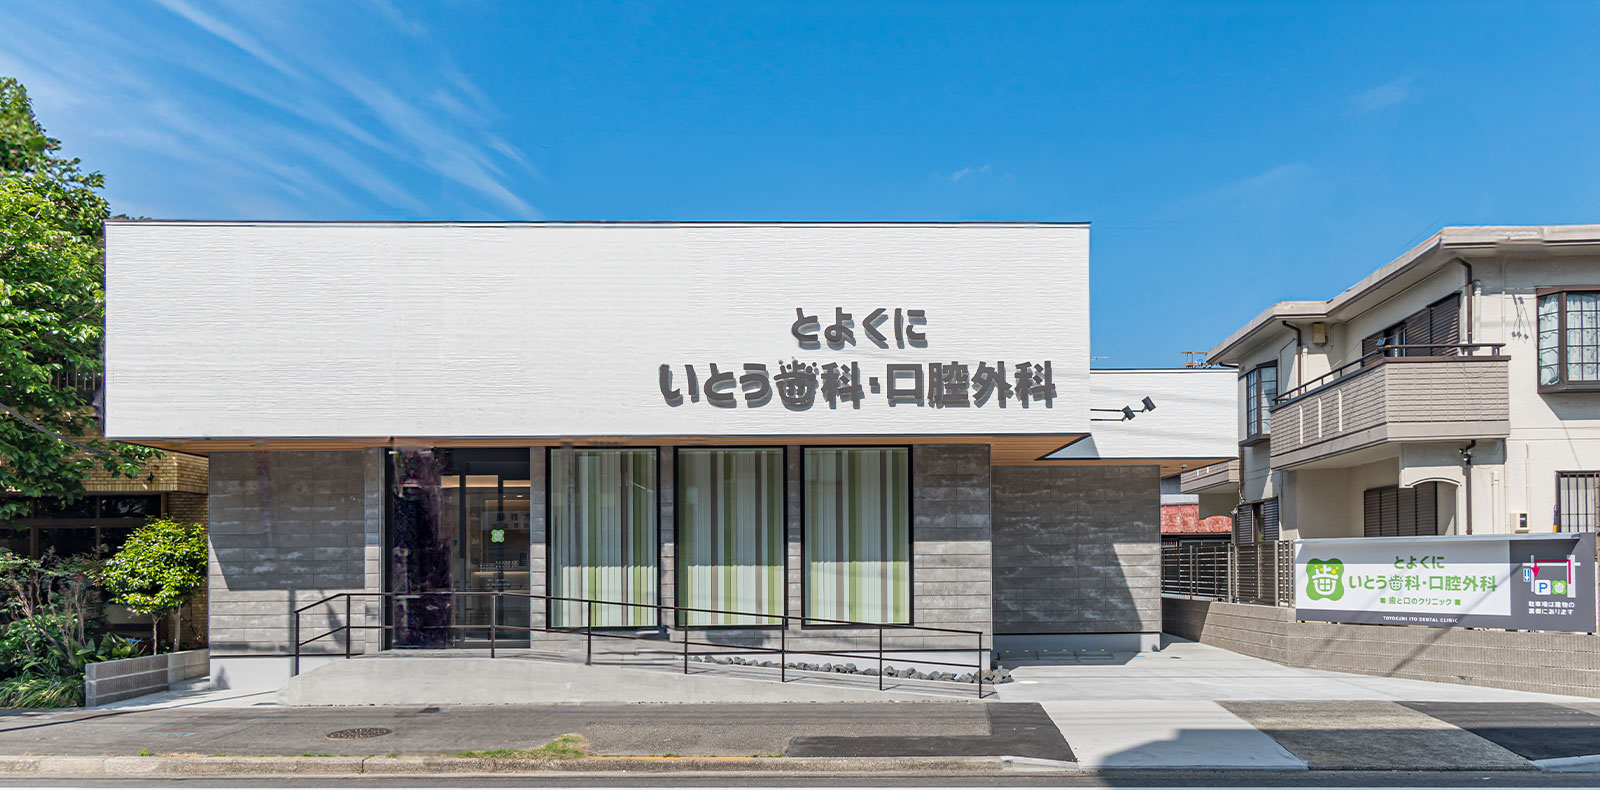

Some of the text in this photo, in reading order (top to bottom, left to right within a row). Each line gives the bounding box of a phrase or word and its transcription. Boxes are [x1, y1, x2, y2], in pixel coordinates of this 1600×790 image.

[791, 306, 928, 349] とよくに
[1393, 555, 1445, 569] とよくに
[1539, 582, 1548, 593] P
[1388, 596, 1452, 606] 歯と口のクリニック
